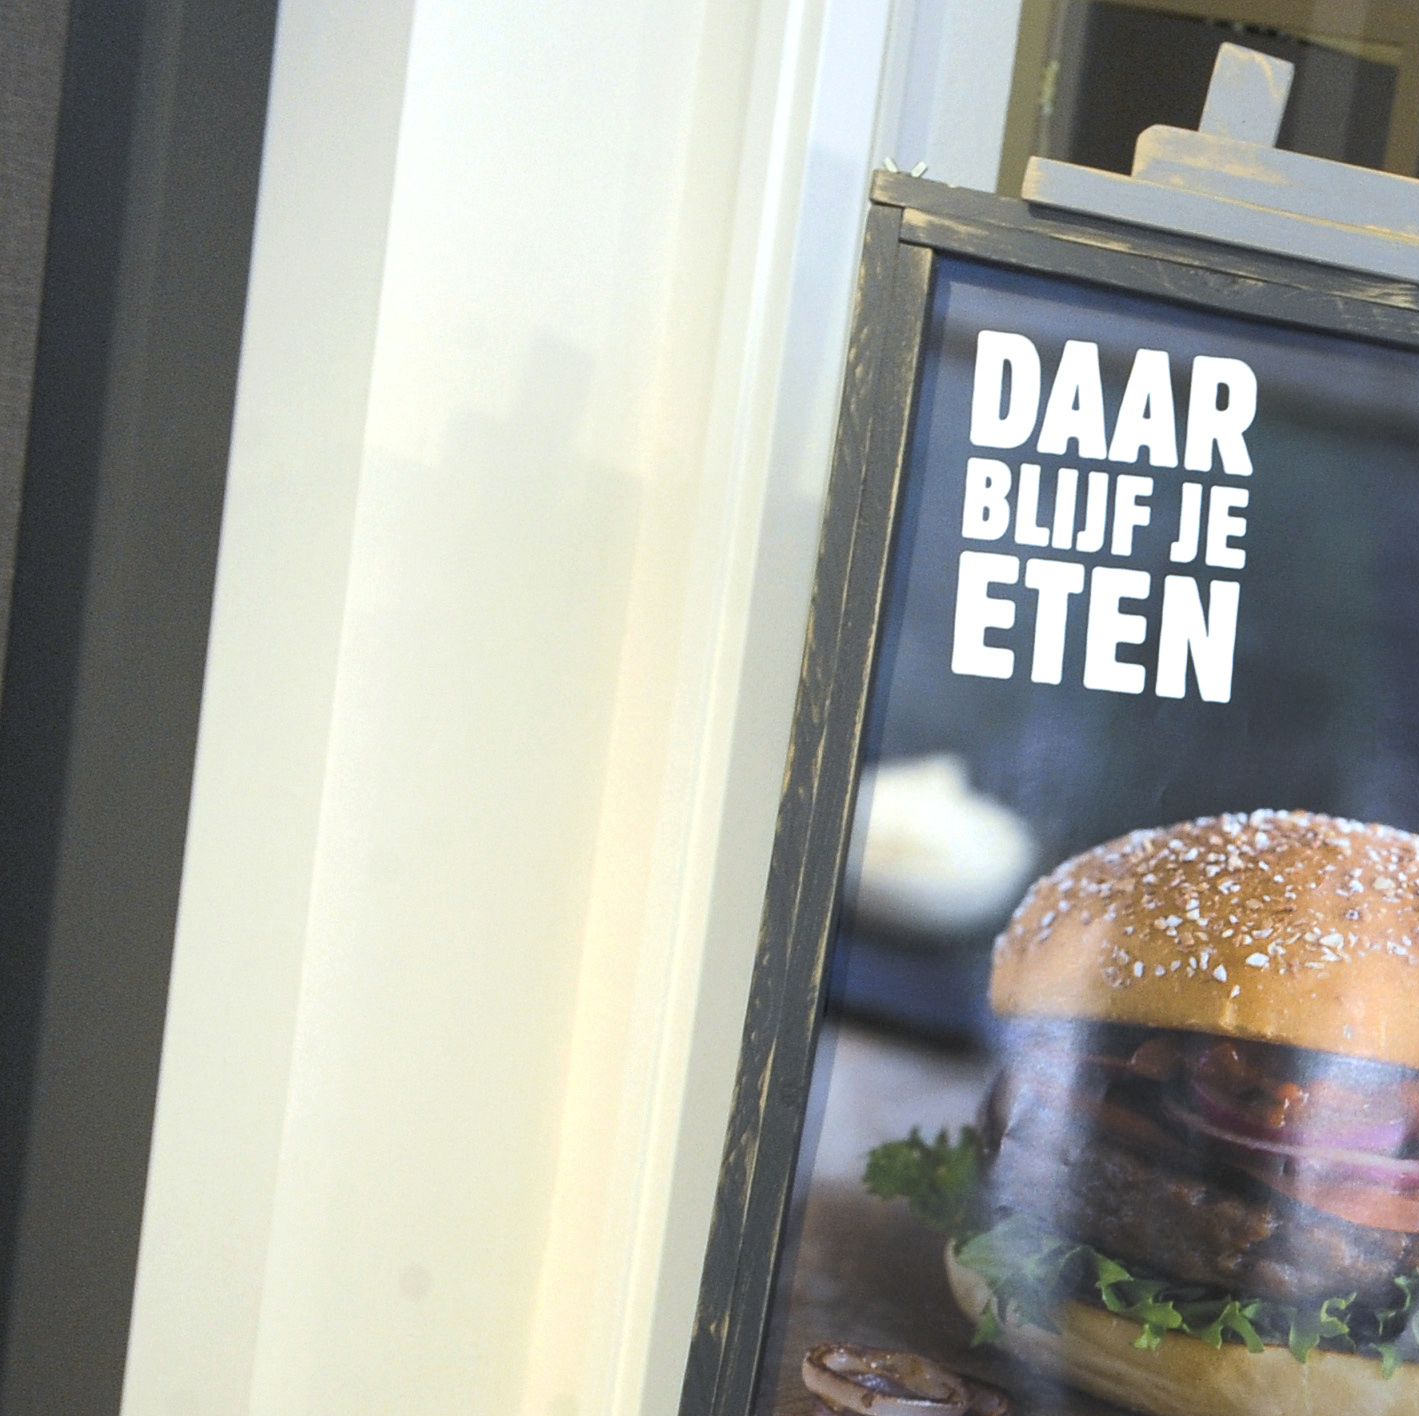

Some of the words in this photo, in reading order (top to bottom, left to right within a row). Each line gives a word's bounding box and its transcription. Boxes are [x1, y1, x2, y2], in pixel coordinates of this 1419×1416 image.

[970, 329, 1258, 476] DAAR
[961, 457, 1154, 556] BLIJF
[1170, 502, 1249, 569] JE
[951, 550, 1240, 703] ETEN
